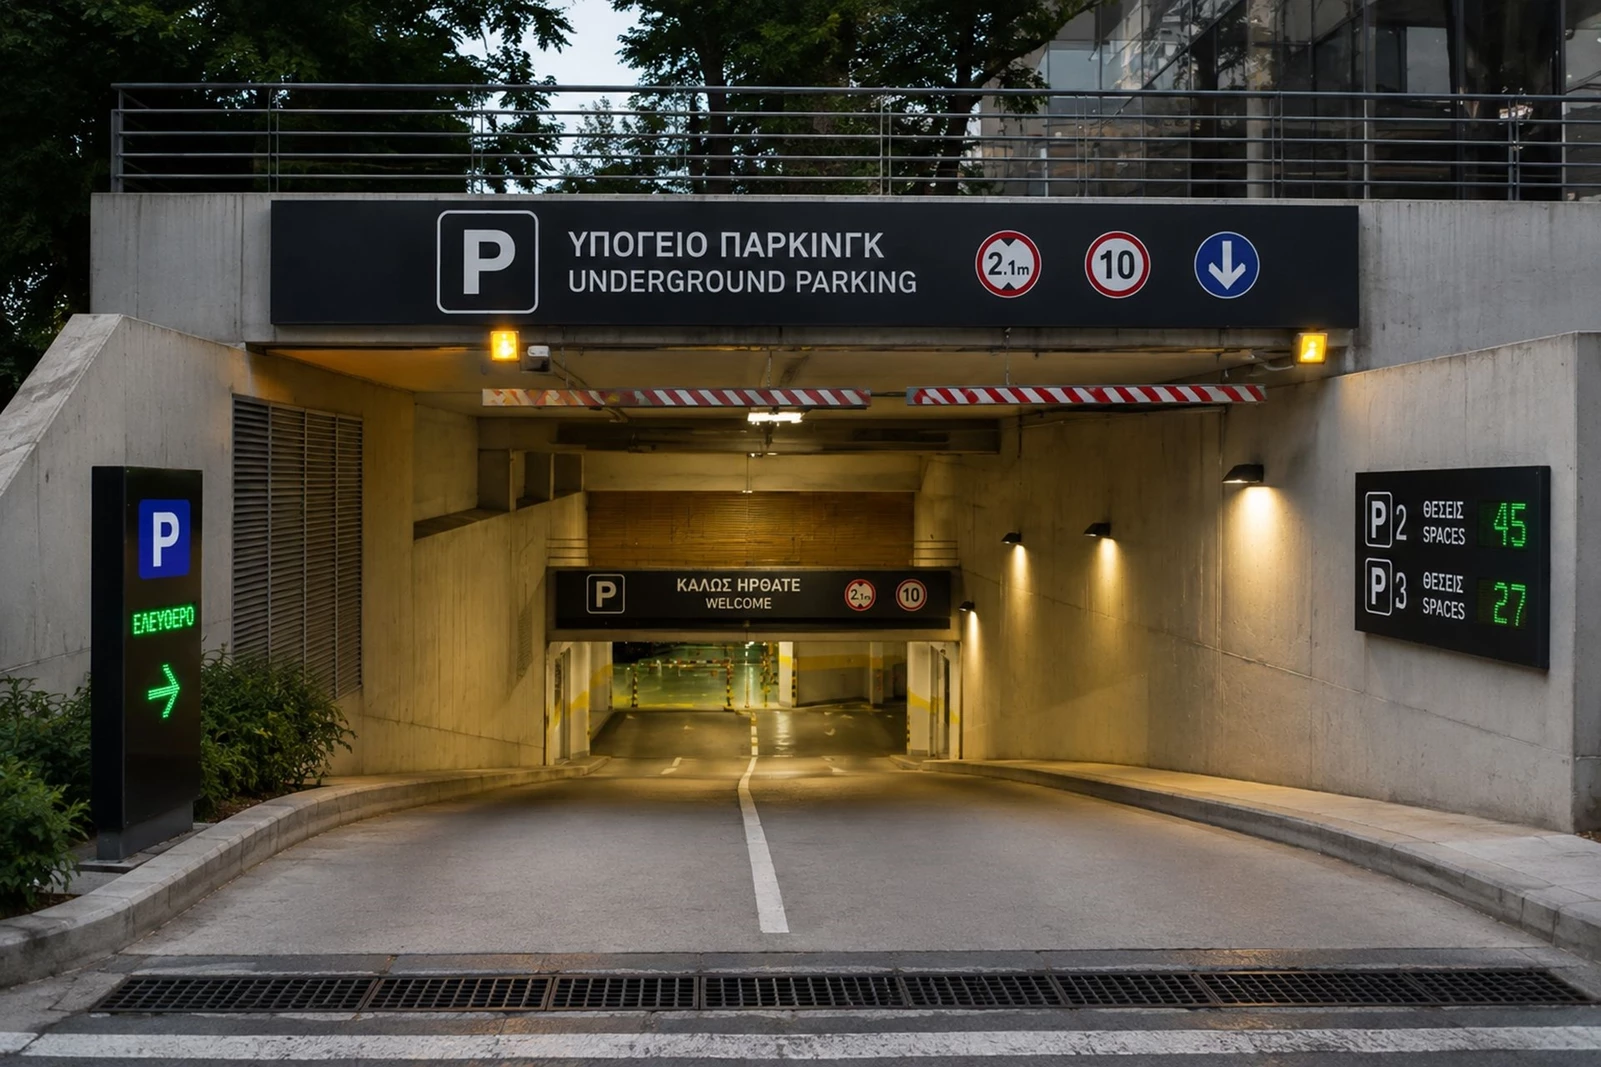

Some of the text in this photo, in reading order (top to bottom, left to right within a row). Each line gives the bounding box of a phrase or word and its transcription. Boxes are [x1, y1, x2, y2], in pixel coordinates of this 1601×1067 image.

[568, 231, 885, 259] ΥΠΟΓΕΙΟ ΠΑΡΚΙΝΓΚ
[464, 230, 515, 295] P
[987, 251, 1030, 276] 2.1m
[1100, 250, 1135, 279] 10
[569, 270, 917, 295] UNDERGROUND PARKING
[1370, 500, 1387, 539] P
[1423, 500, 1464, 519] ΘΕΣΕΙΣ
[1422, 526, 1466, 546] SPACES
[1493, 502, 1526, 547] 45
[153, 511, 180, 567] P
[596, 580, 617, 608] P
[677, 578, 801, 592] ΚΑΛΩΣ ΗΡΘΑΤΕ
[902, 587, 920, 603] 10
[1370, 566, 1387, 605] P
[1423, 571, 1464, 594] ΘΕΣΕΙΣ
[705, 597, 772, 610] WELCOME
[1422, 597, 1466, 620] SPACES
[1493, 581, 1526, 627] 27
